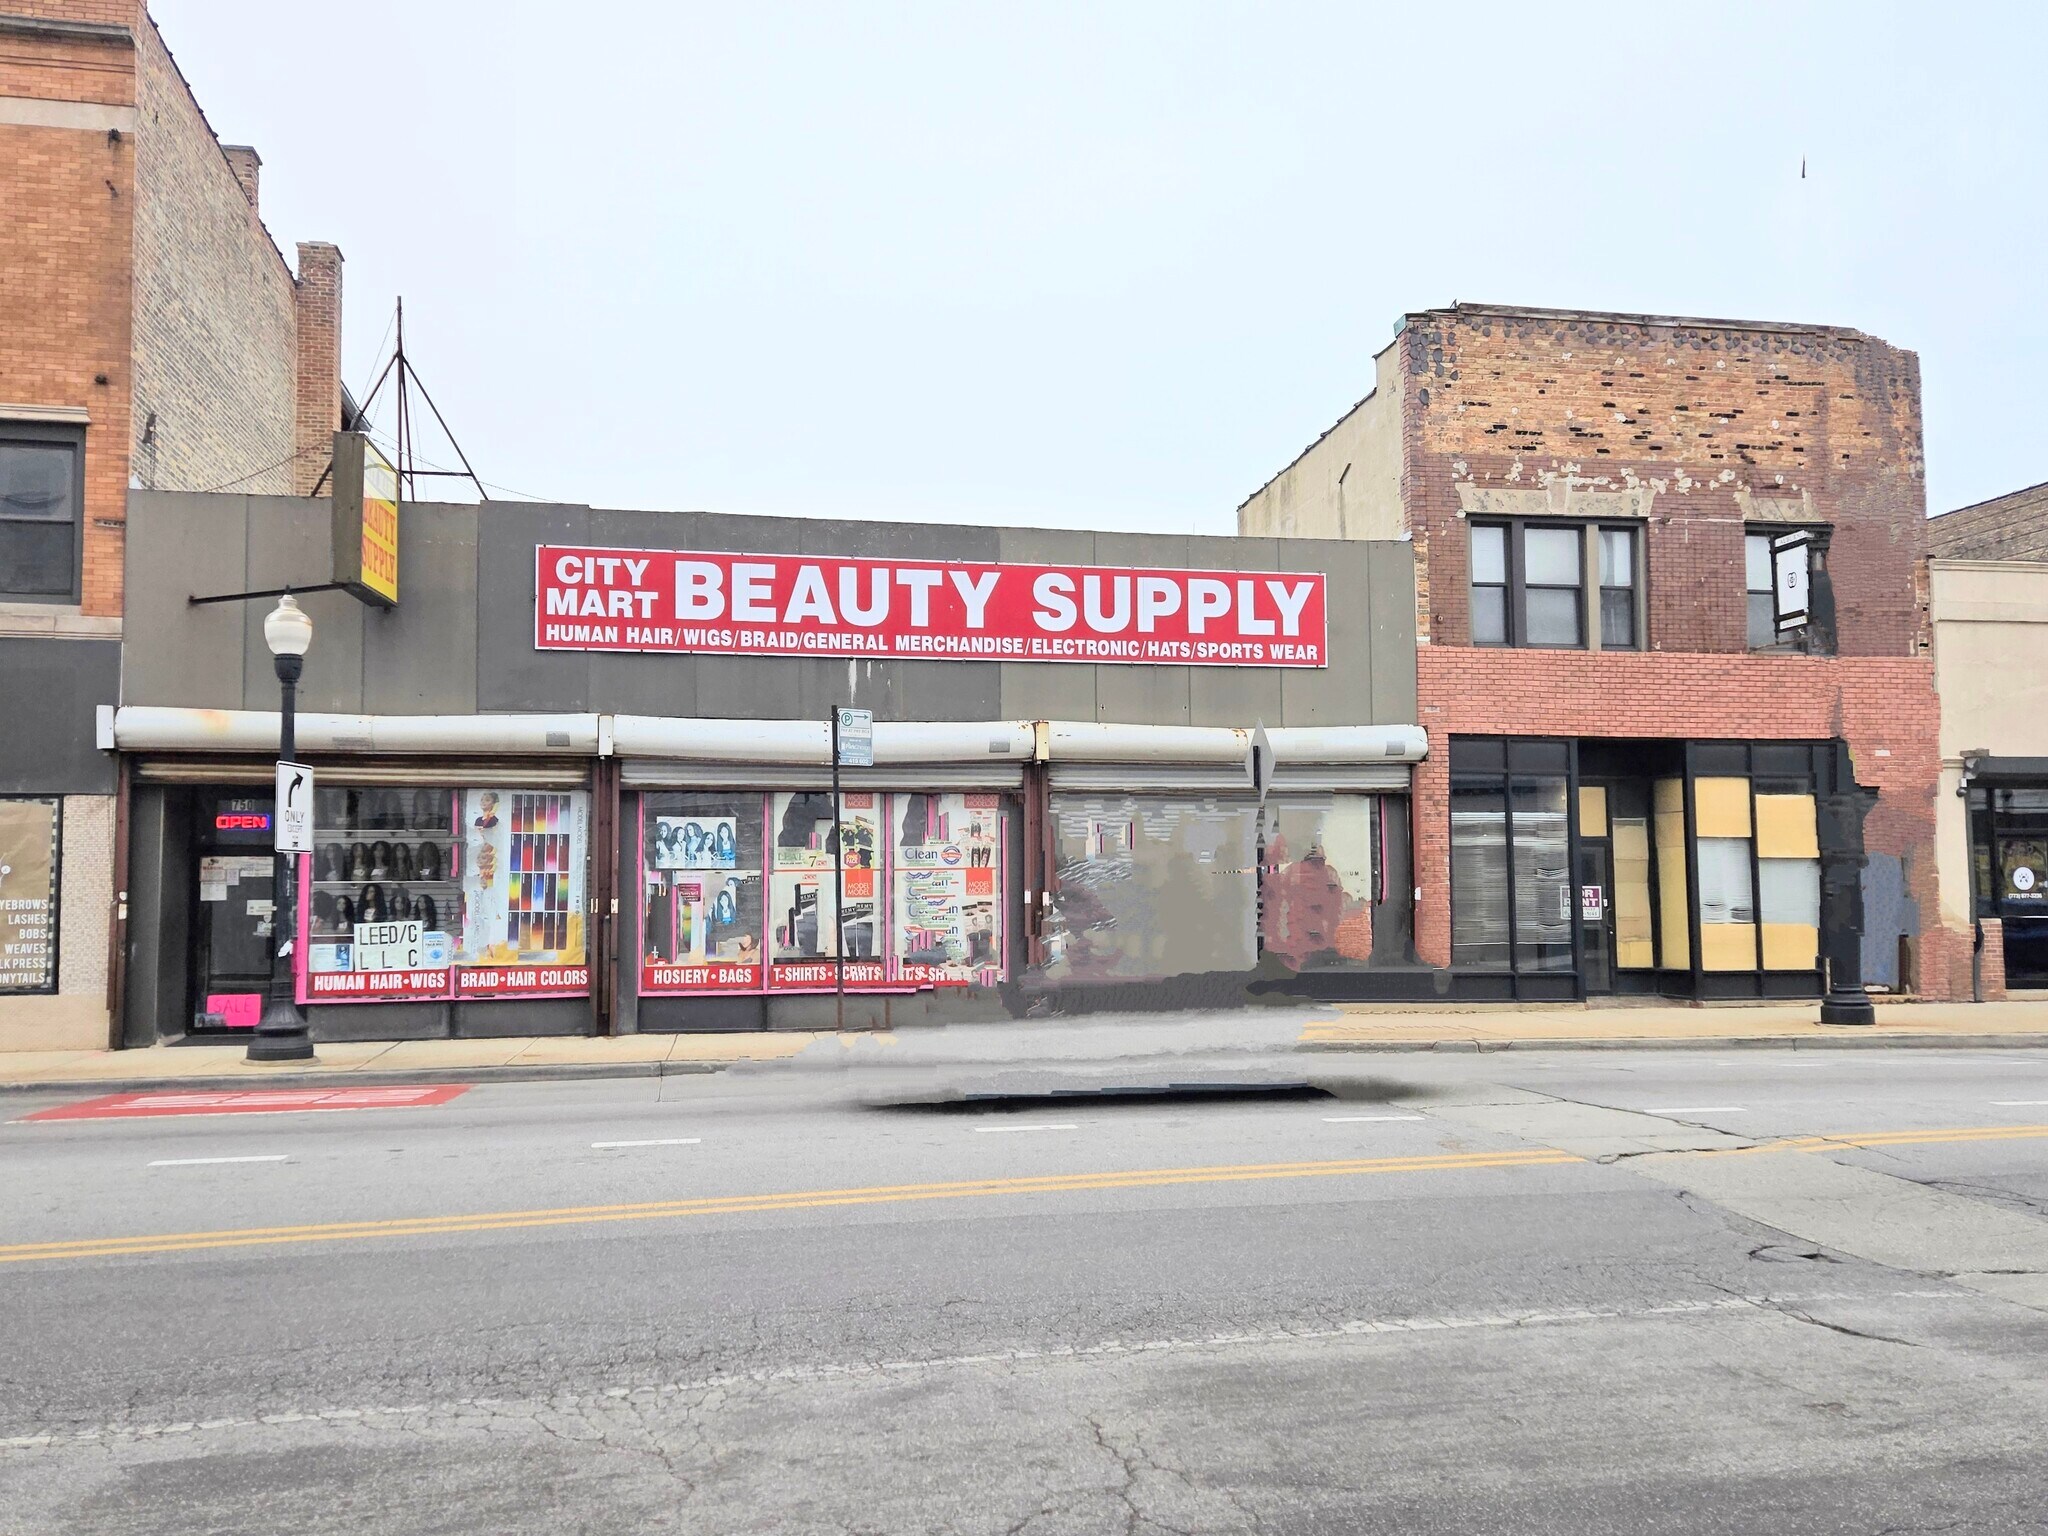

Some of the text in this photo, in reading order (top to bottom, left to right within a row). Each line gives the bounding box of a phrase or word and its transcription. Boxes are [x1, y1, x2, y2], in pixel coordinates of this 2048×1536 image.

[555, 556, 651, 587] CITY
[546, 587, 659, 619] MART
[675, 560, 1315, 637] BEAUTY SUPPLY
[546, 624, 618, 643] HUMAN
[1270, 643, 1318, 661] WEAR
[216, 816, 267, 829] OPEN
[285, 810, 304, 824] ONLY
[905, 848, 933, 859] Clean
[8, 914, 47, 925] LASHES
[19, 928, 47, 939] BOBS
[5, 943, 46, 954] WEAVES
[13, 957, 46, 969] PRESS
[540, 970, 588, 986] COLORS
[653, 968, 752, 985] HOSIERY BAGS
[773, 966, 827, 982] T-SHIRTS
[314, 974, 365, 991] HUMAN
[214, 997, 251, 1014] SALE
